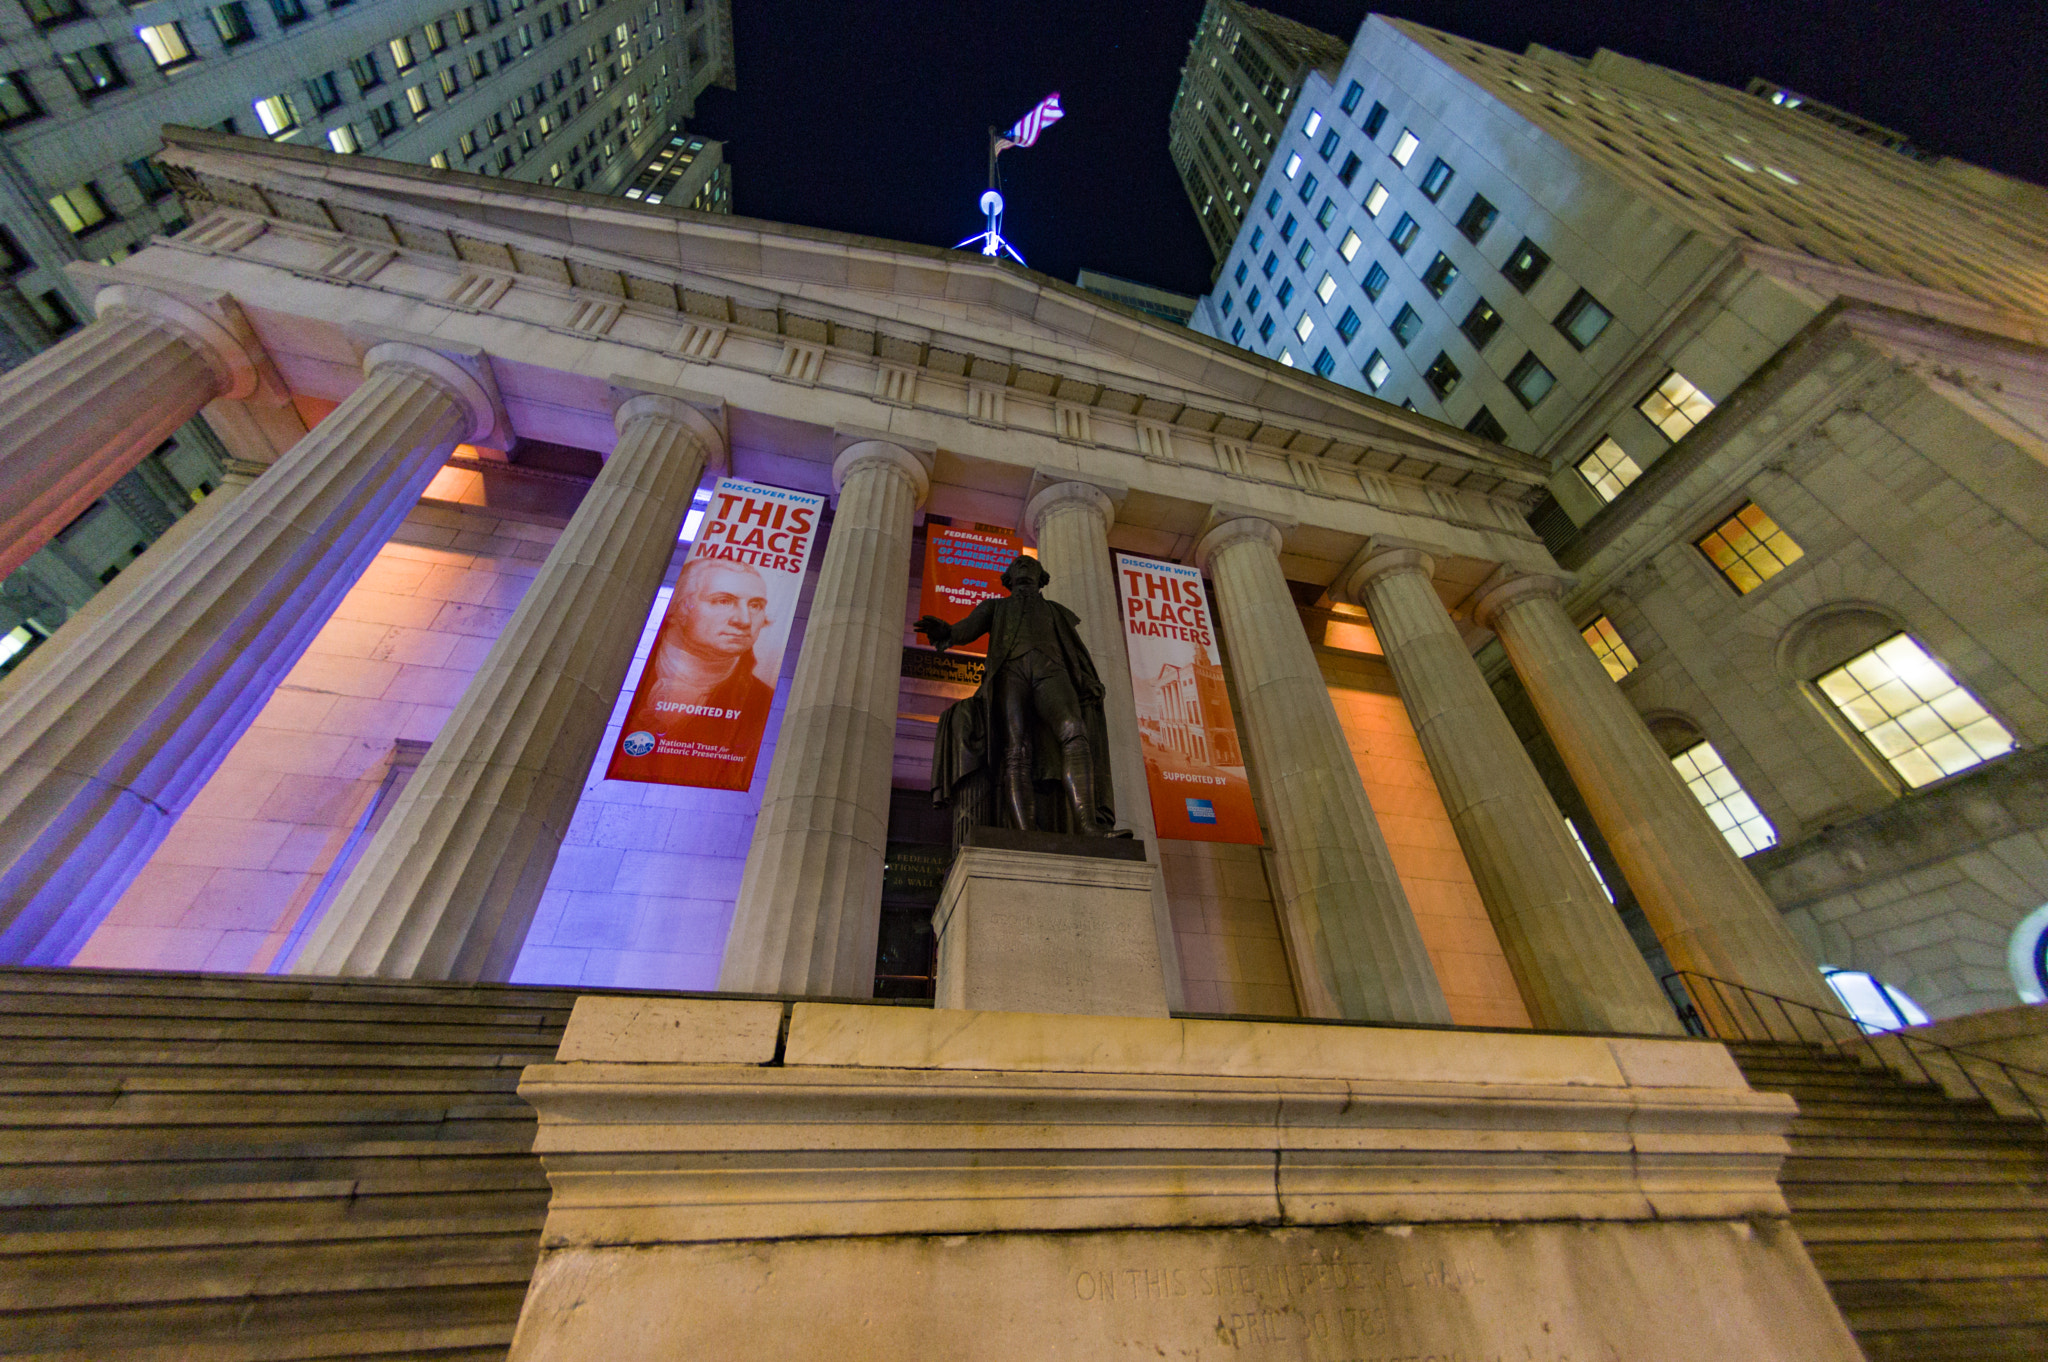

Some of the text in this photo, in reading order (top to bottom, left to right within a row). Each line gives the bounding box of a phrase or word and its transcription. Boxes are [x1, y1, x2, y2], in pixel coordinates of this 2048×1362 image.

[722, 482, 819, 505] DISCOVER WHY
[717, 493, 815, 534] THIS
[703, 520, 808, 558] PLACE
[932, 537, 1019, 557] THE BIRTHPLACE
[944, 530, 1008, 545] FEDERAL HALL
[695, 542, 802, 574] MATTERS
[937, 556, 1008, 573] GOVERNMEN
[938, 547, 1012, 564] OF AMERICAN
[1121, 558, 1198, 577] DISCOVER WHY
[962, 578, 988, 588] OPEN
[1123, 569, 1203, 608] THIS
[1127, 597, 1208, 630] PLACE
[1129, 619, 1211, 647] MATTERS
[655, 701, 741, 720] SUPPORTED BY
[656, 746, 744, 762] Historic Preservation
[659, 739, 730, 754] National Trust for
[1162, 771, 1226, 785] SUPPORTED BY
[1076, 1270, 1117, 1300] ON
[1125, 1268, 1187, 1299] THIS
